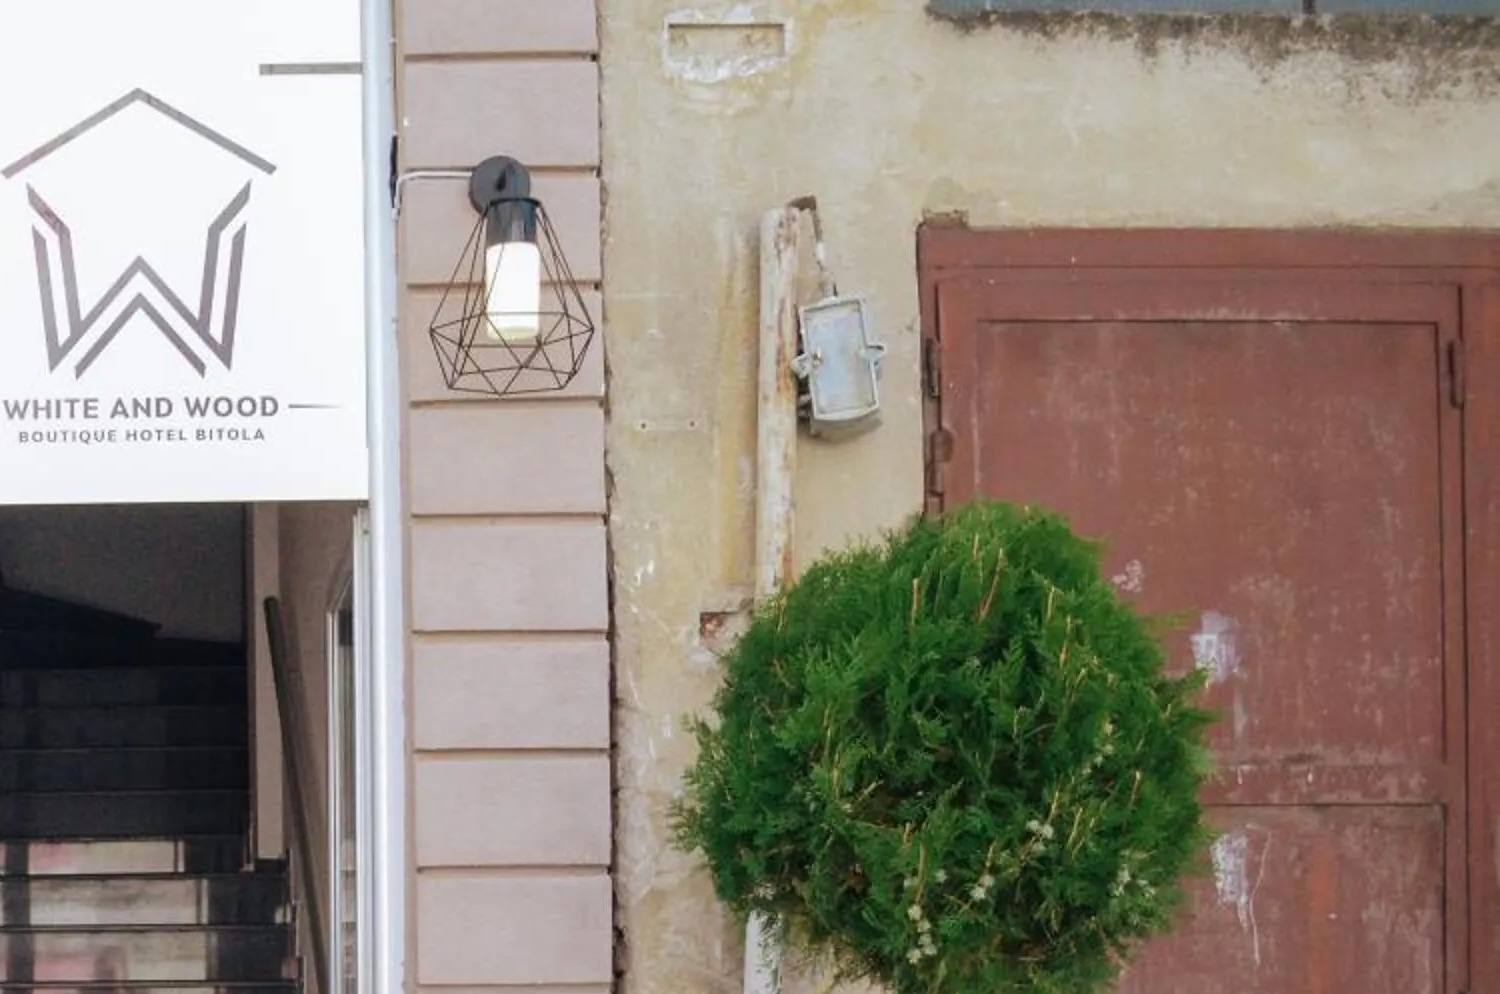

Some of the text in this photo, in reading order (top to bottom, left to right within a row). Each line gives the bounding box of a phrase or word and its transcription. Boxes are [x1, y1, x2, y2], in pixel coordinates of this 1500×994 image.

[2, 395, 279, 421] WHITE AND WOOD
[18, 427, 265, 445] BOUTIQUE HOTEL BITOLA
